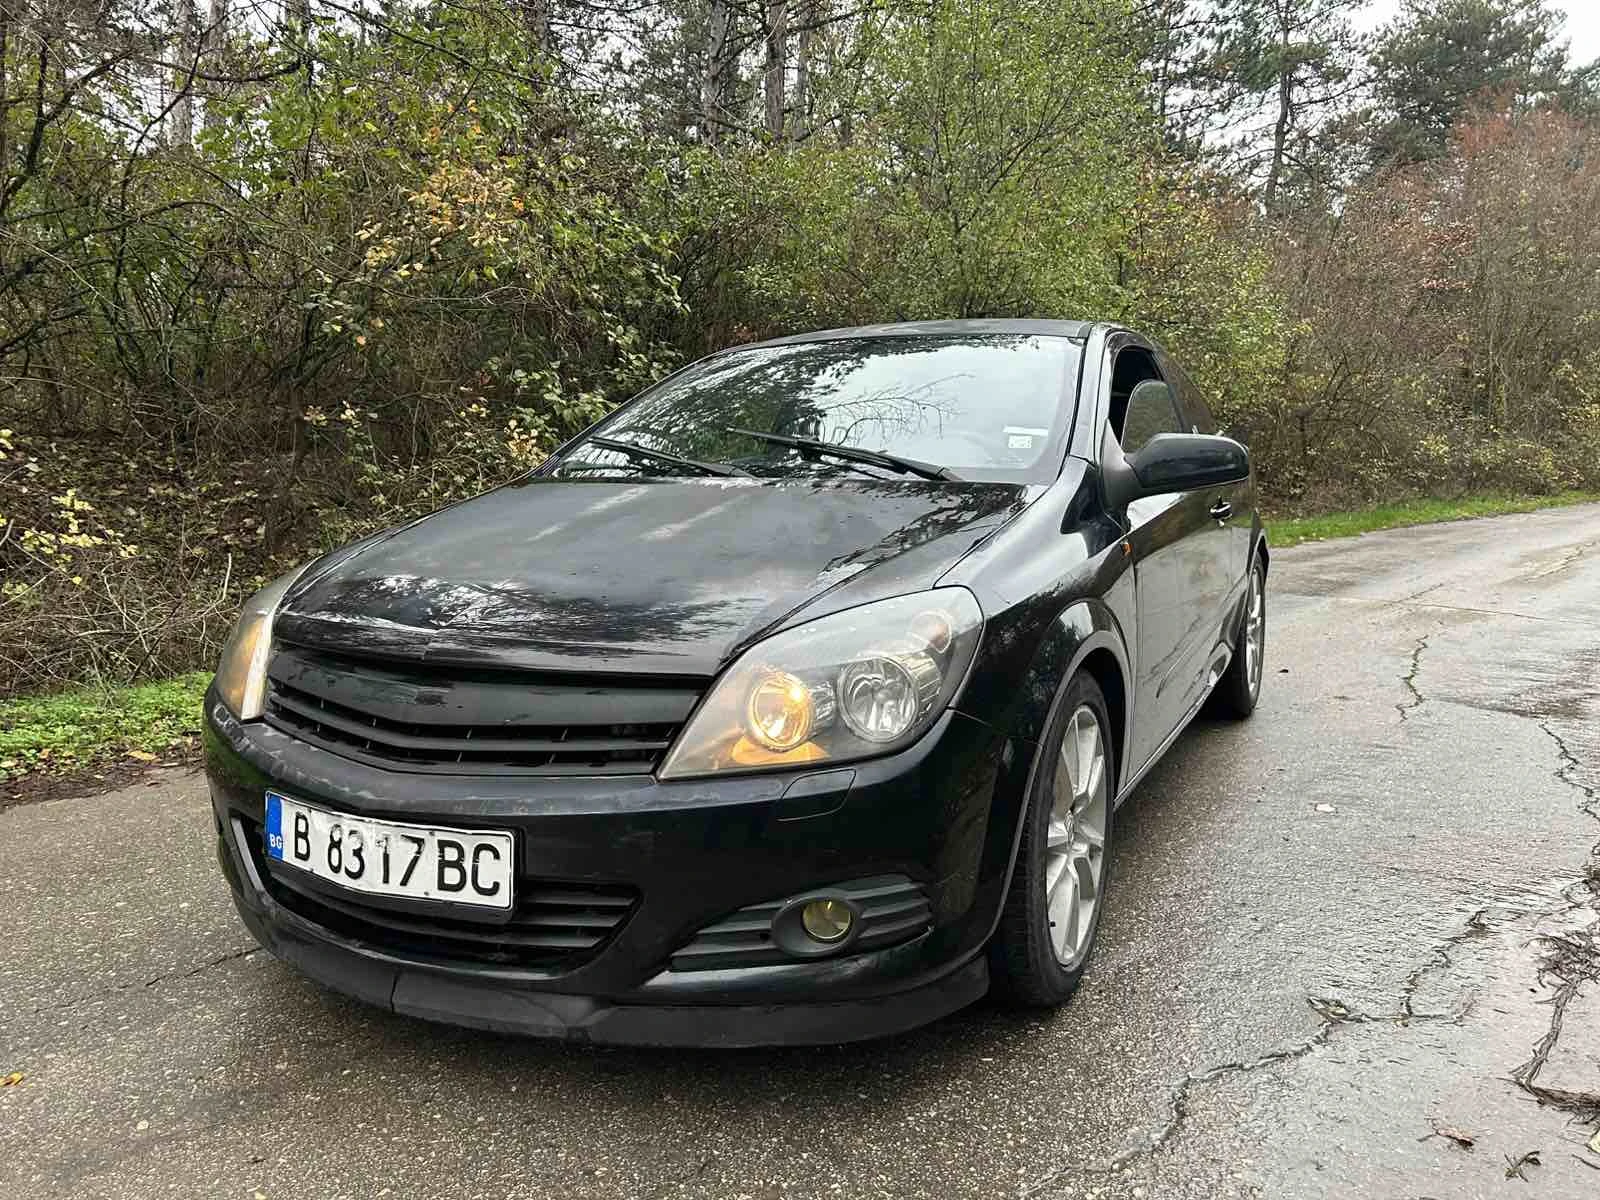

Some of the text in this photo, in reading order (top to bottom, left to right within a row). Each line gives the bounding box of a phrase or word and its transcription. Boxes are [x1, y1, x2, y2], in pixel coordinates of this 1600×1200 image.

[269, 834, 283, 848] BG
[294, 811, 500, 896] B 8317 BC
